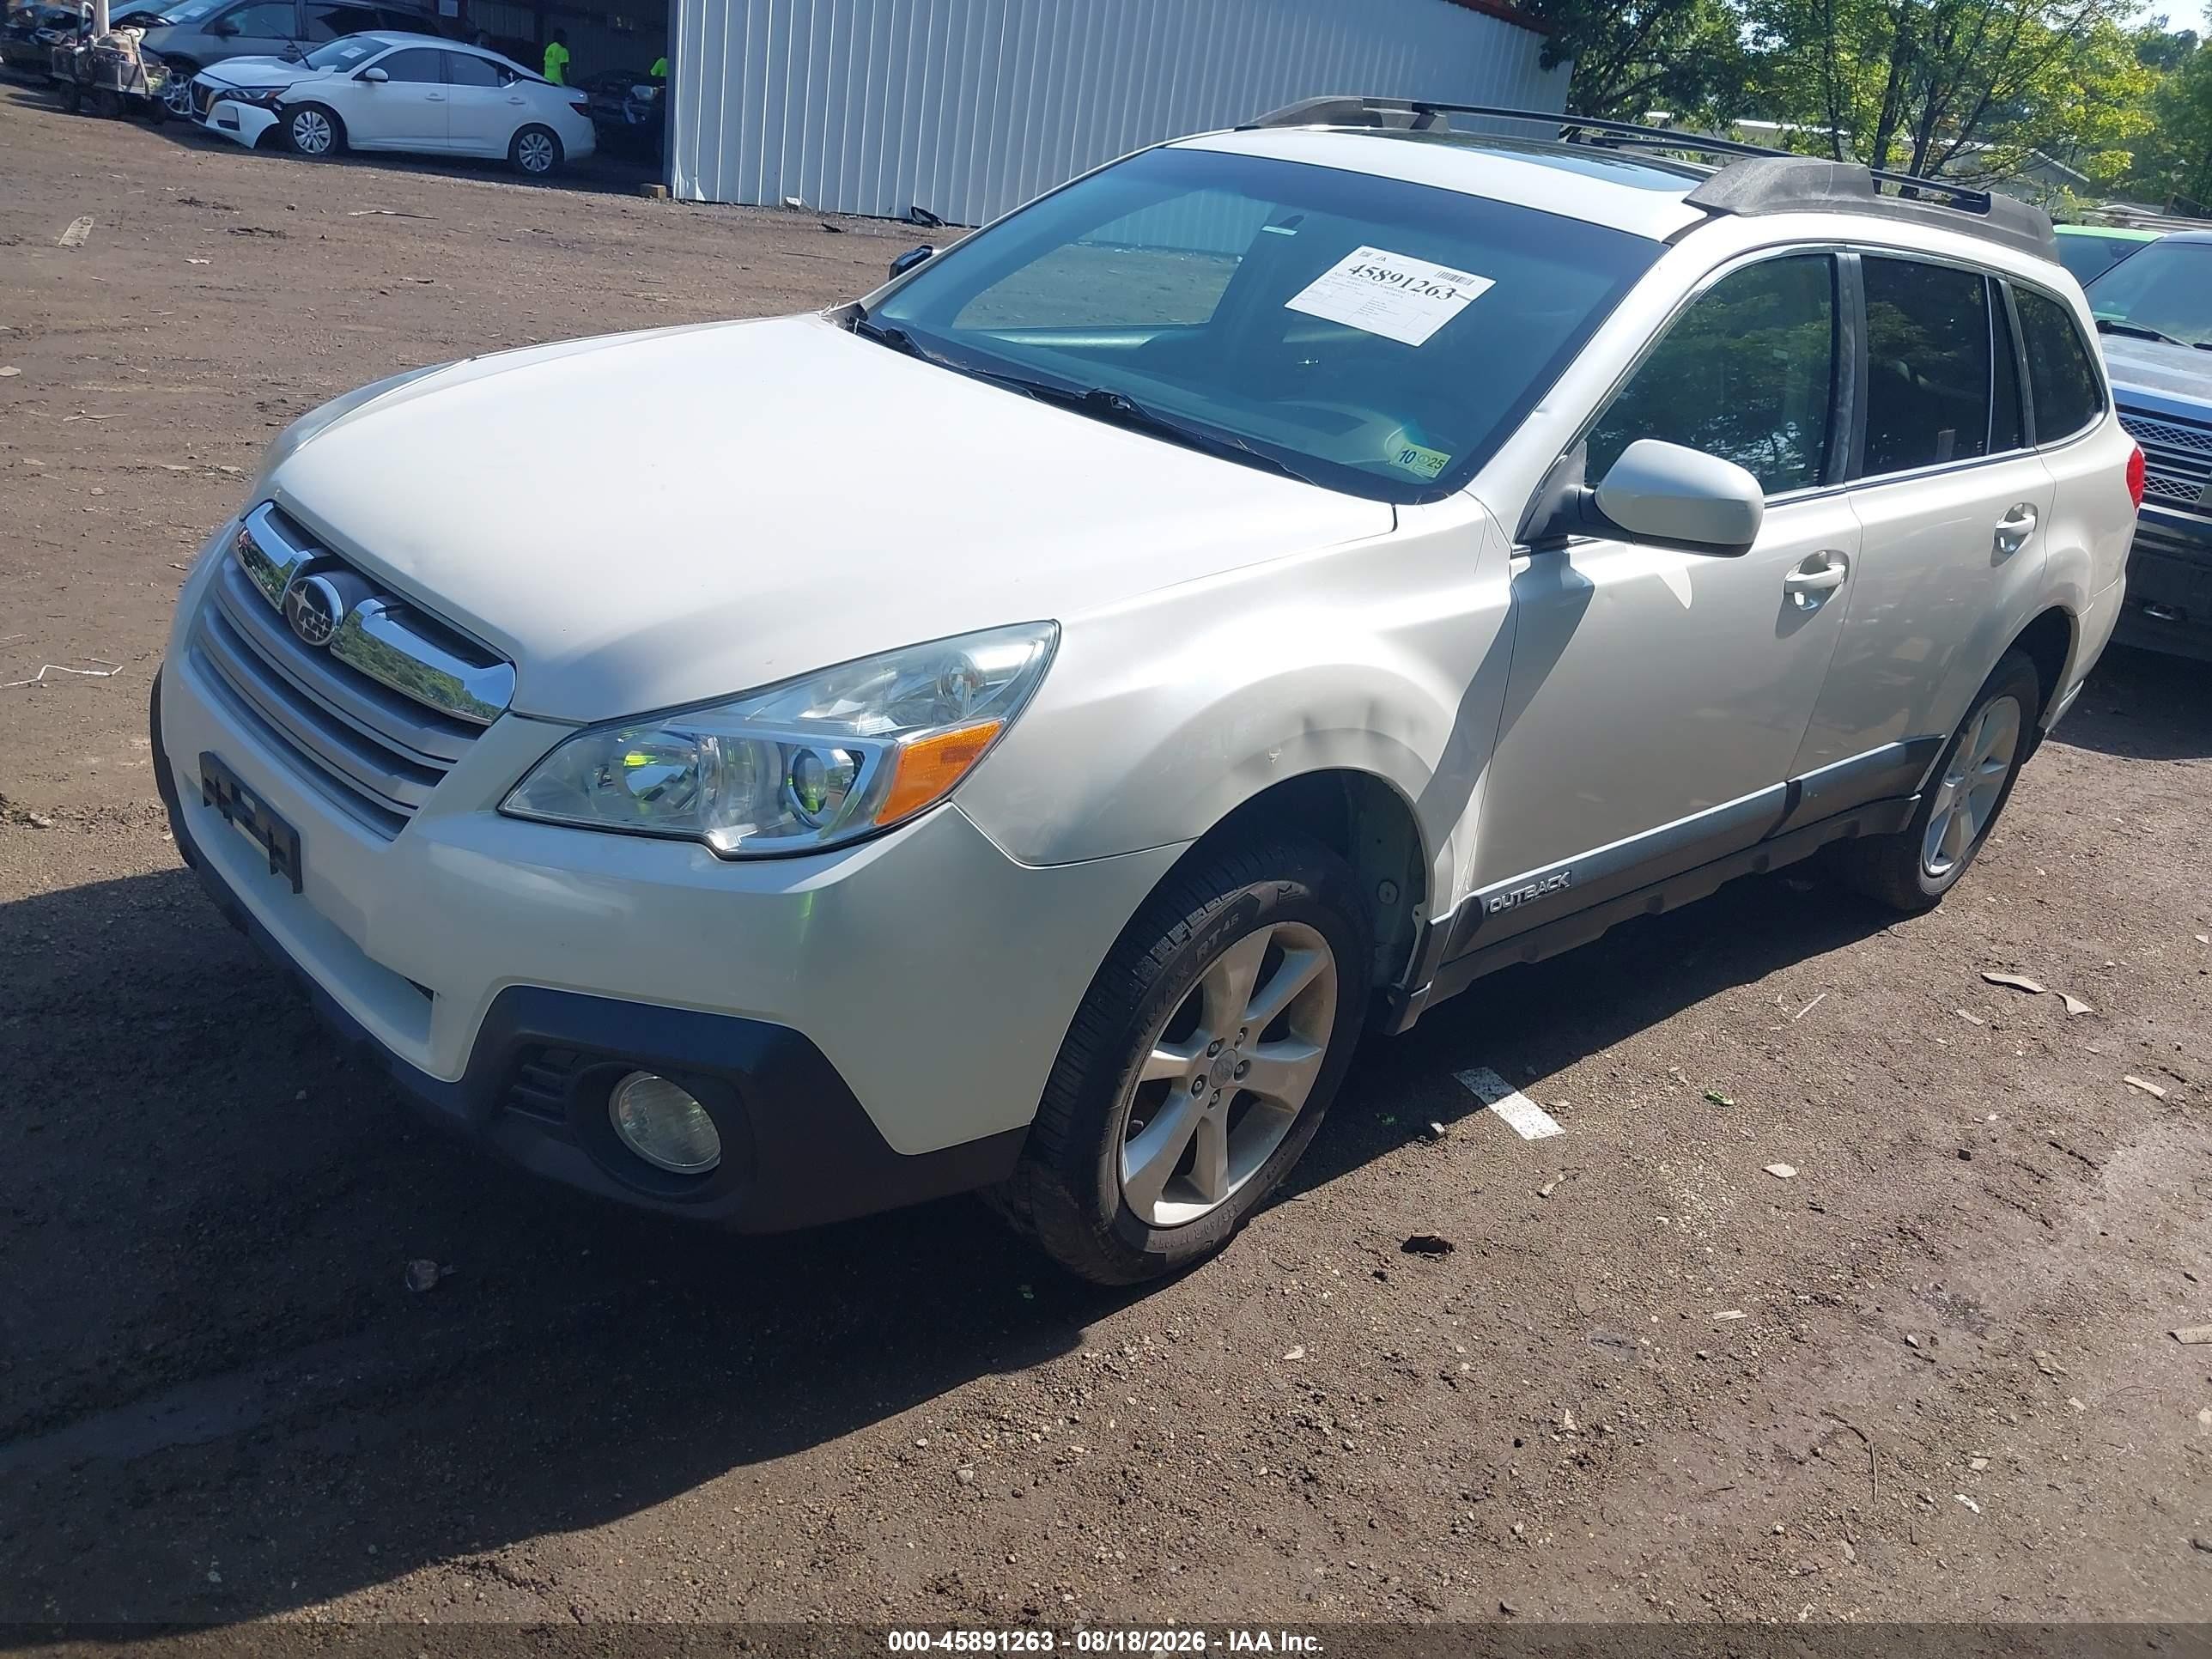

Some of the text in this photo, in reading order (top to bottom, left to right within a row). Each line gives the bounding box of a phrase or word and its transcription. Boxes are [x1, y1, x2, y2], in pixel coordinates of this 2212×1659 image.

[1348, 264, 1457, 301] 45891263
[1399, 449, 1445, 470] 10 25
[1489, 872, 1571, 913] OUTBACK
